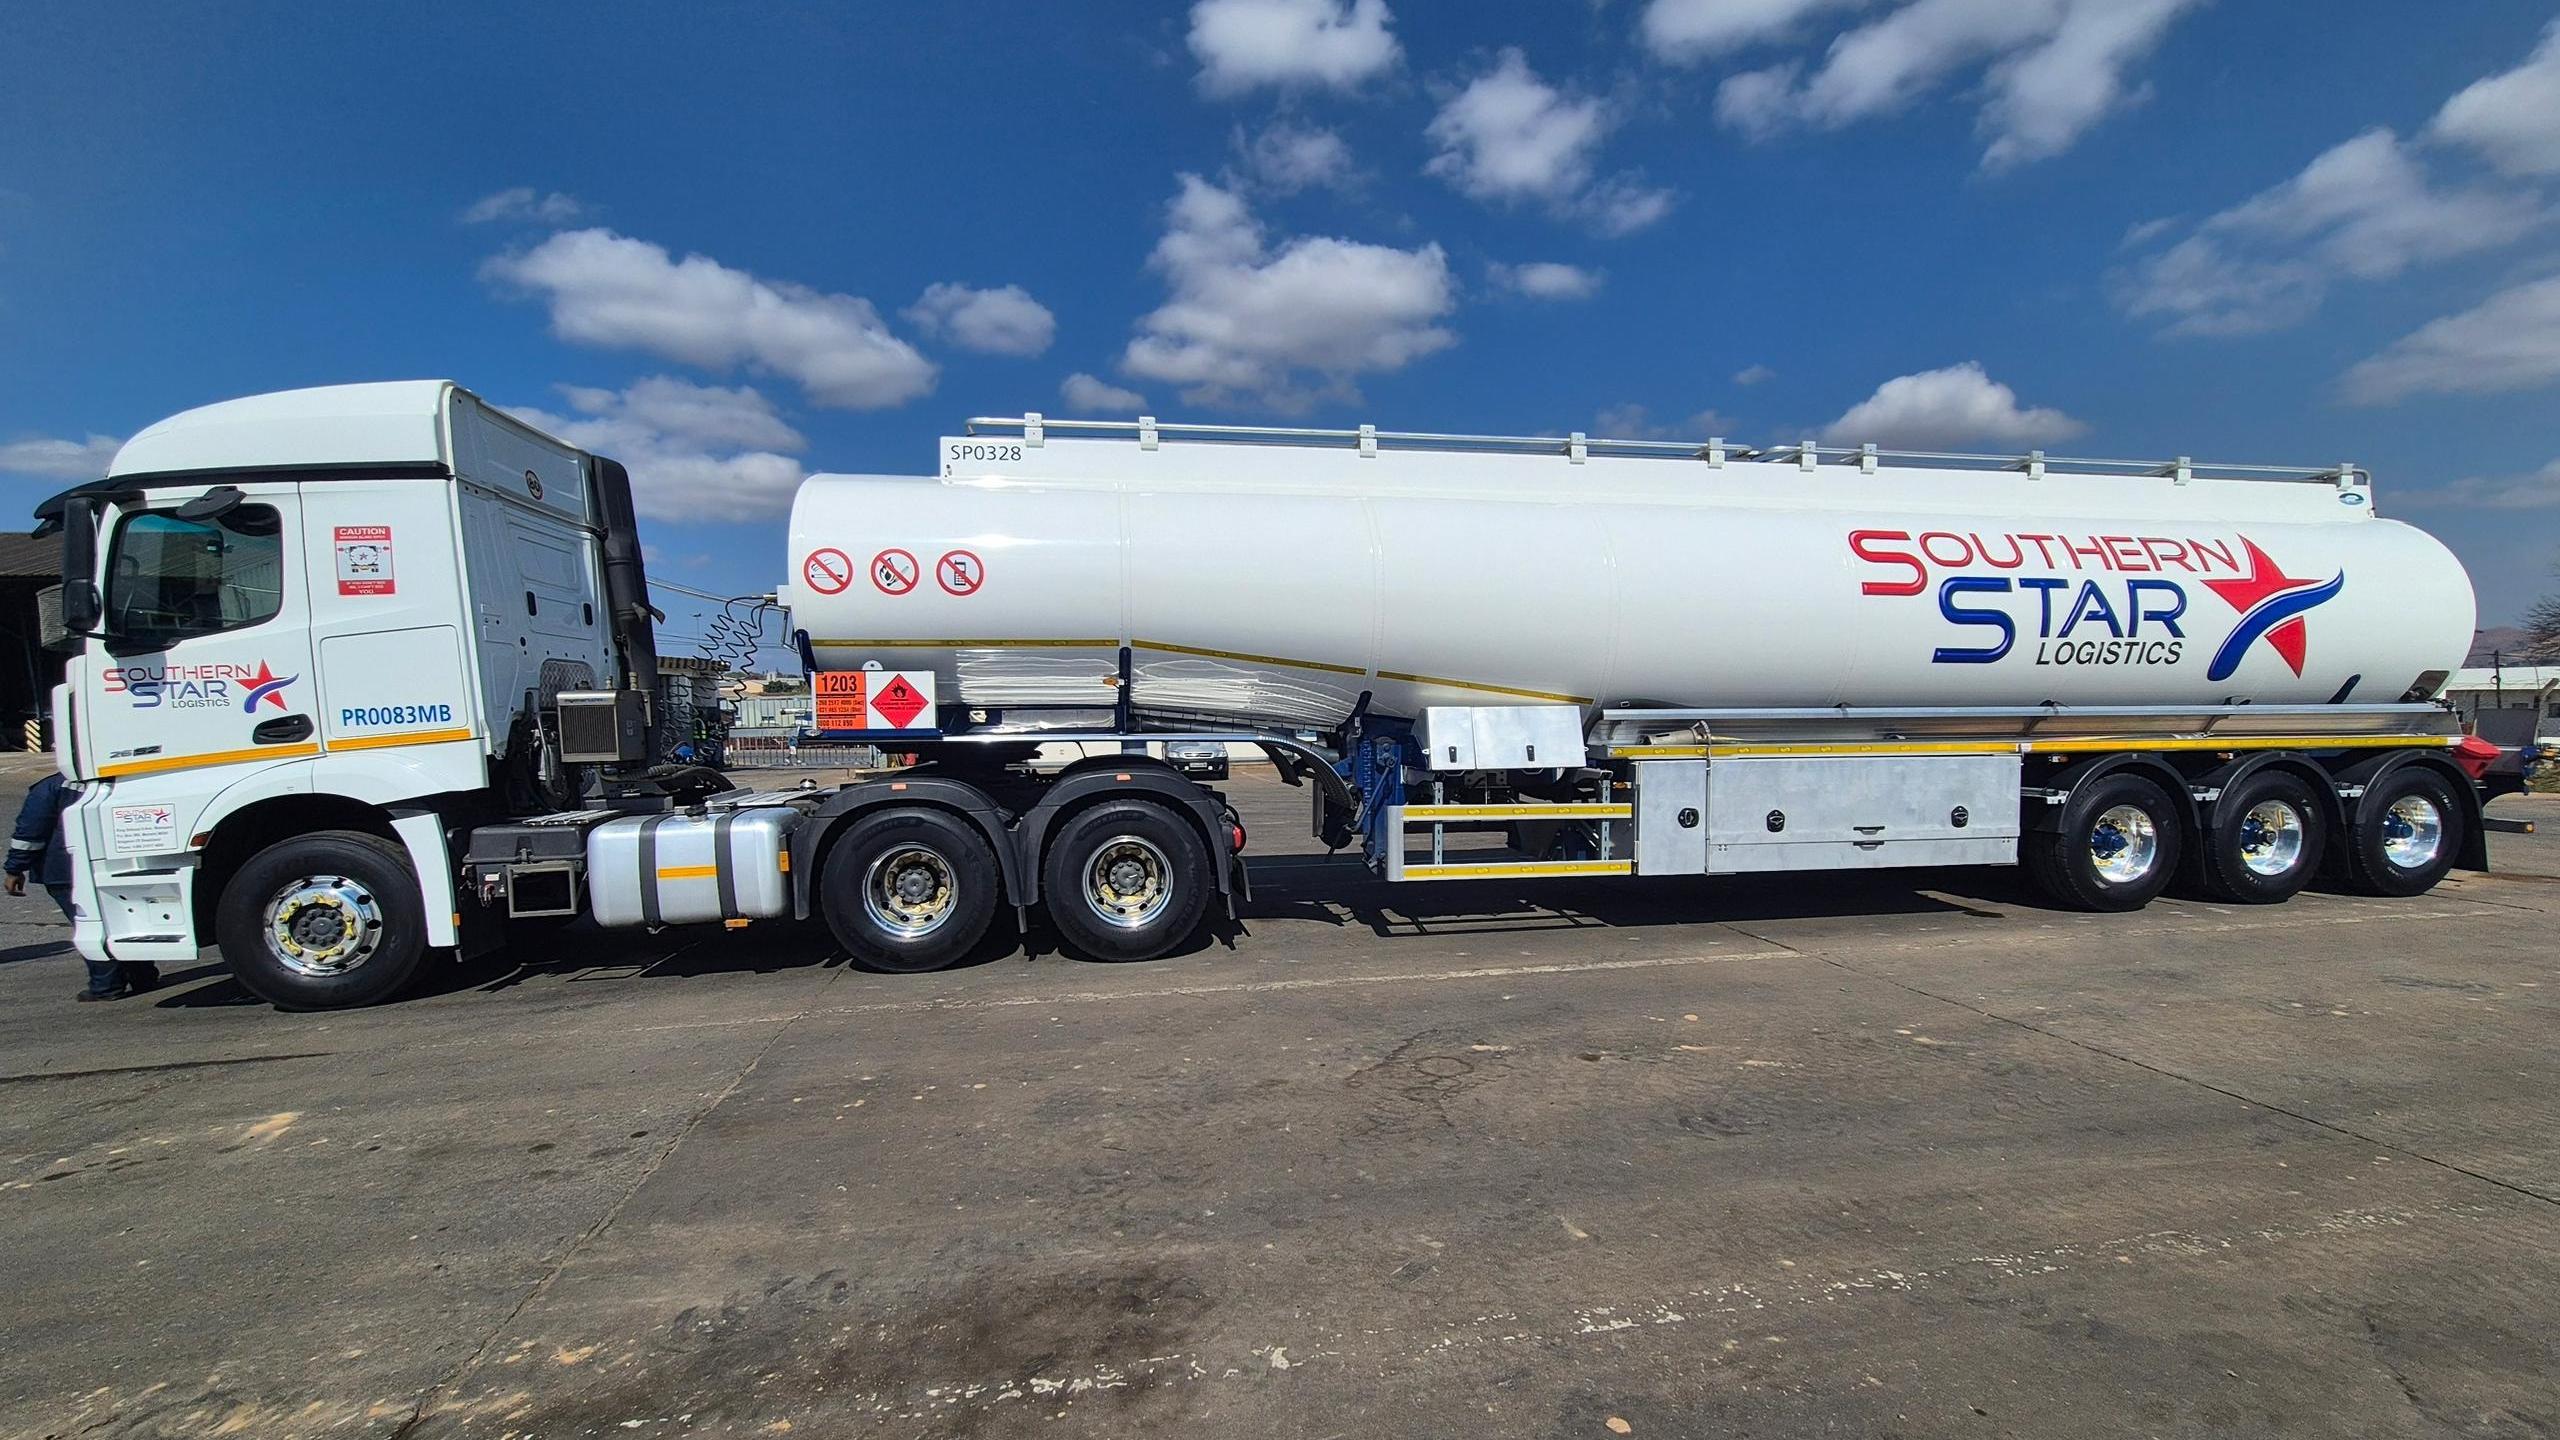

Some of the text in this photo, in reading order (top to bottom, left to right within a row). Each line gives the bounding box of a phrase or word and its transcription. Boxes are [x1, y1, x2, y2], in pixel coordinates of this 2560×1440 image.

[951, 445, 1021, 461] SP0328
[1848, 529, 2241, 596] SOUTHERN
[1932, 576, 2187, 664] STAR
[2035, 641, 2183, 666] LOGISTICS
[102, 664, 251, 692] SOUTHERN
[822, 675, 857, 692] 1203
[129, 680, 229, 708] STAR
[172, 698, 231, 709] LOGISTICS
[341, 704, 452, 727] PR0083MB
